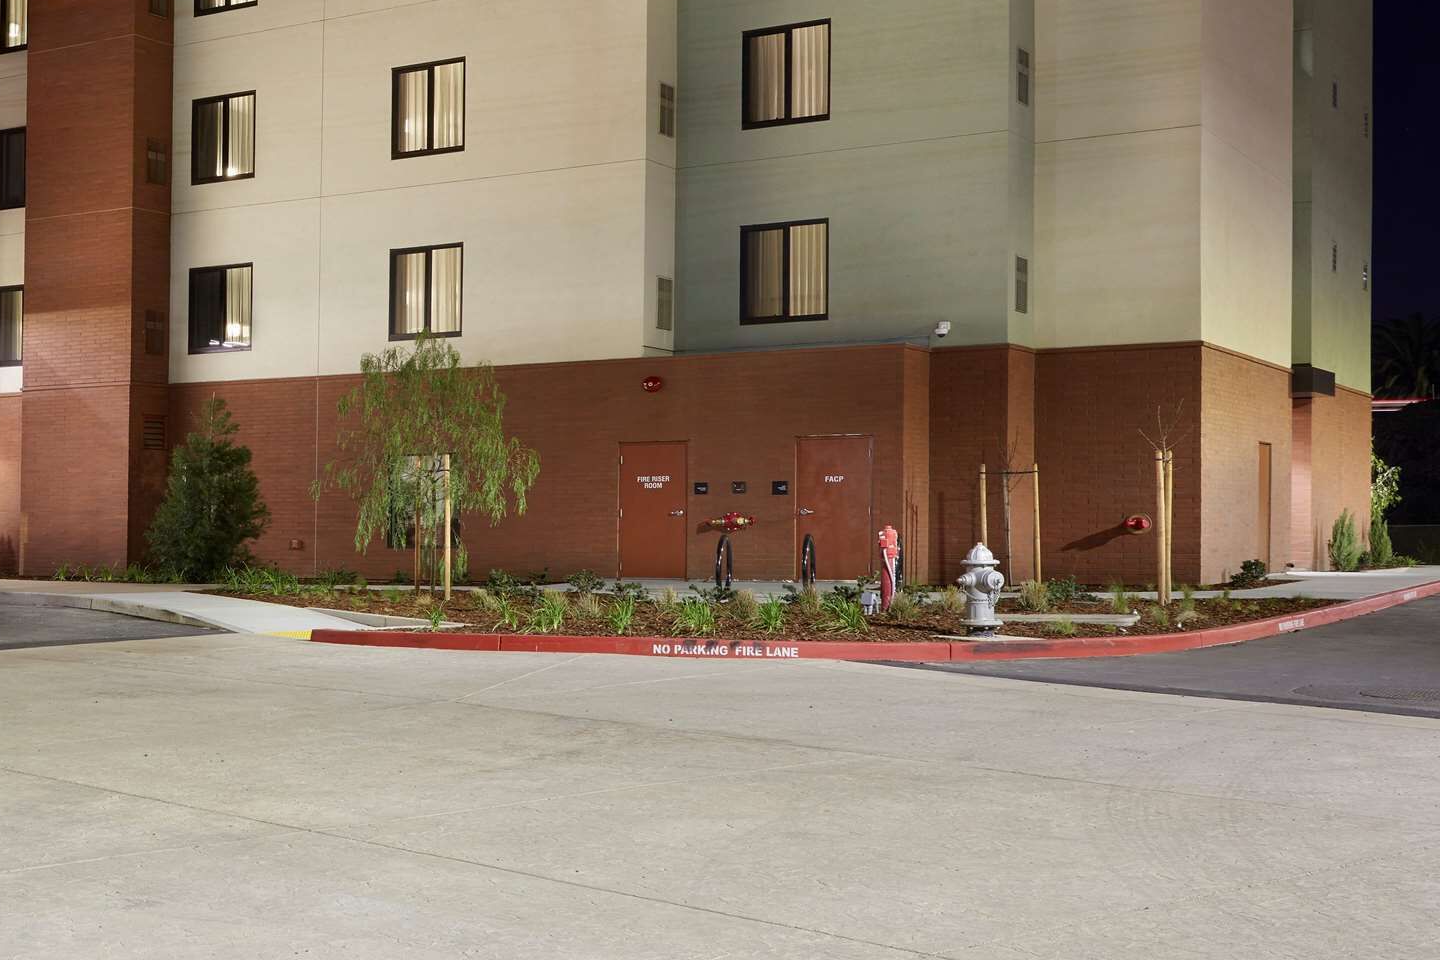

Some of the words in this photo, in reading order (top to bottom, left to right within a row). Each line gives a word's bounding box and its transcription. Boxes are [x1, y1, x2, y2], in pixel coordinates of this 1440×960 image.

[824, 475, 844, 483] FACP
[653, 644, 671, 654] NO
[735, 645, 762, 657] FIRE
[766, 646, 799, 658] LANE
